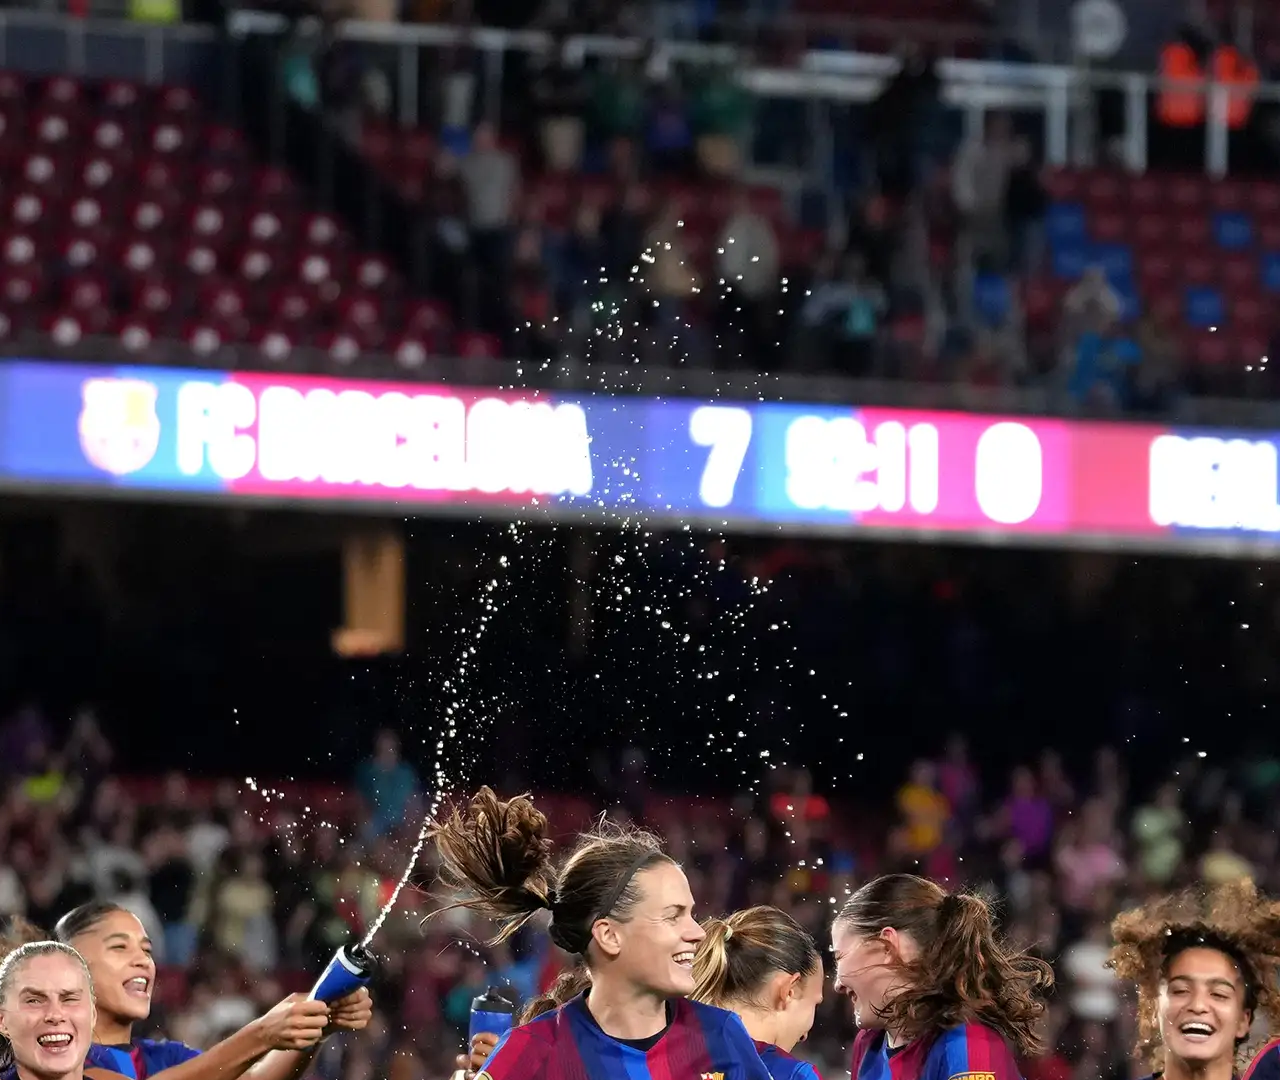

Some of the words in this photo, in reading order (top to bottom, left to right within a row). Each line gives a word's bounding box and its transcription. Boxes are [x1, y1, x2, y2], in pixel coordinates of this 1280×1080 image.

[177, 380, 256, 479] FC
[689, 406, 752, 507] 7
[975, 422, 1042, 524] 0
